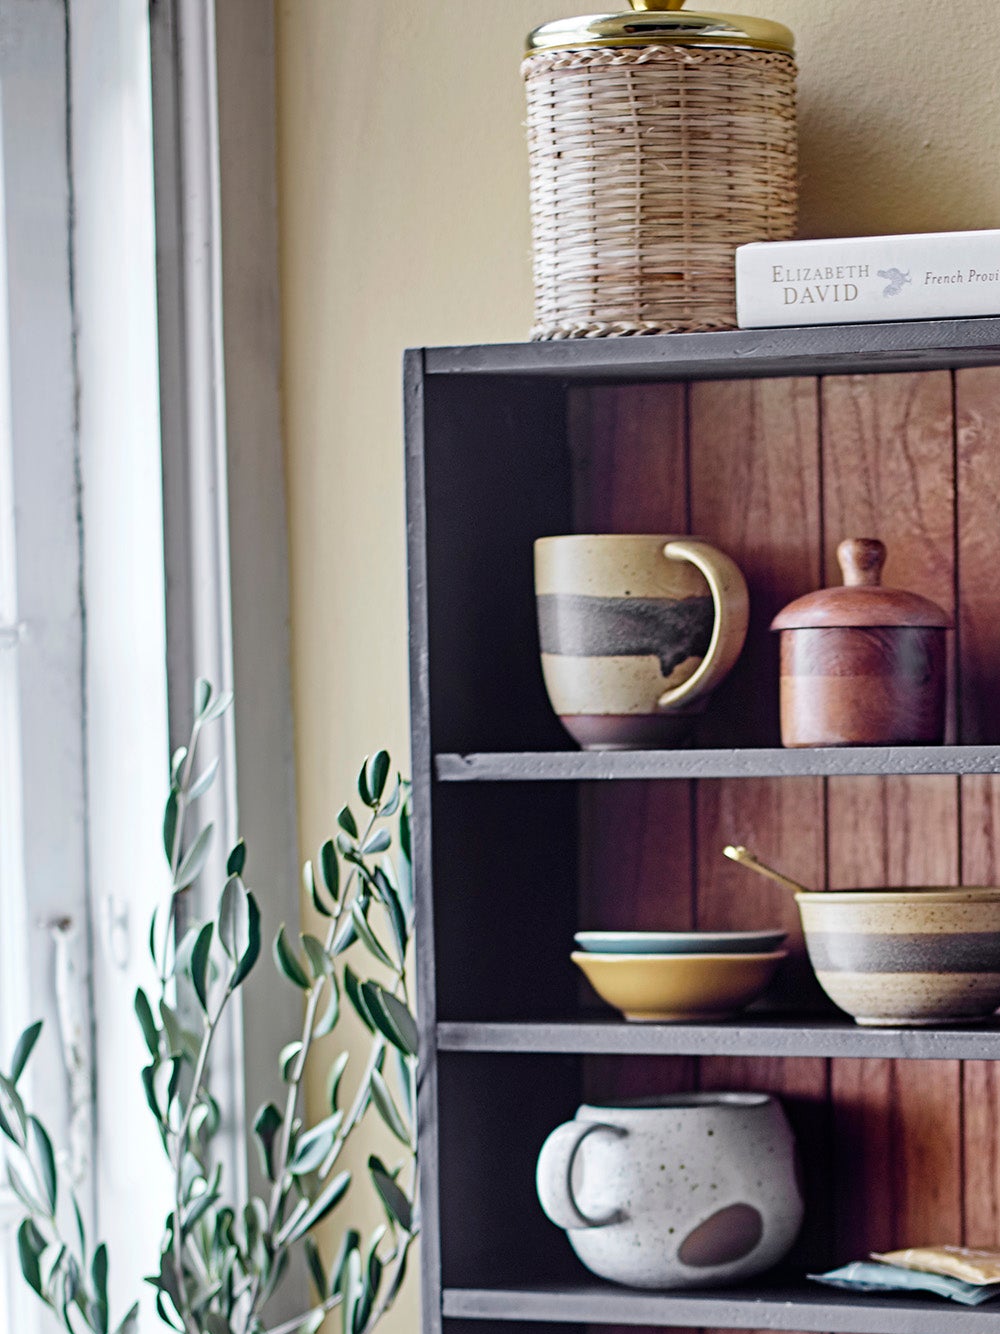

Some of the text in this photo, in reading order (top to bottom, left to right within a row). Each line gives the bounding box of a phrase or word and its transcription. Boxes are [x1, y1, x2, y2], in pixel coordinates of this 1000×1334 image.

[772, 264, 869, 283] ELIZABETH
[924, 269, 963, 285] French
[783, 283, 858, 305] DAVID
